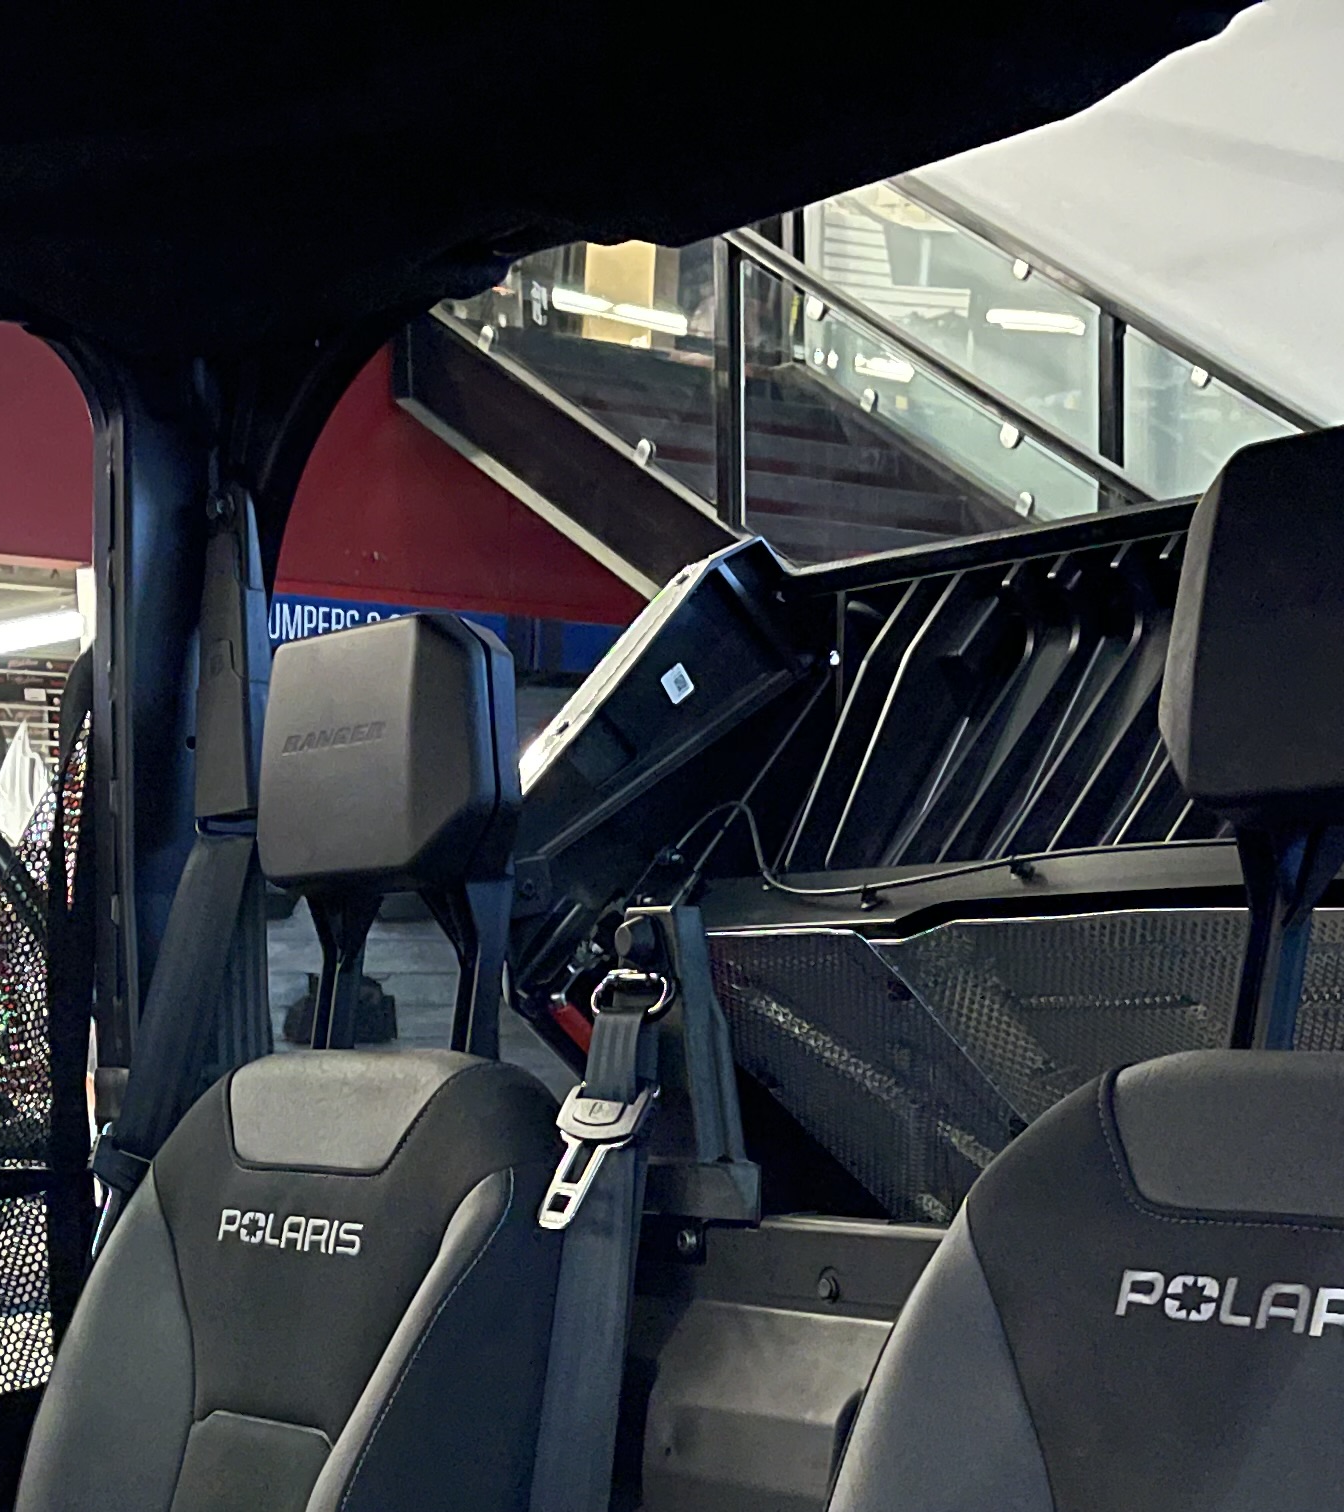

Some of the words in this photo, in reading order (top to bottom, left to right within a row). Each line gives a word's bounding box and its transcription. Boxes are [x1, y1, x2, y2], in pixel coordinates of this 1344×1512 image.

[268, 602, 360, 640] UMPER
[281, 720, 387, 757] RANGER
[216, 1208, 365, 1257] POLARIS
